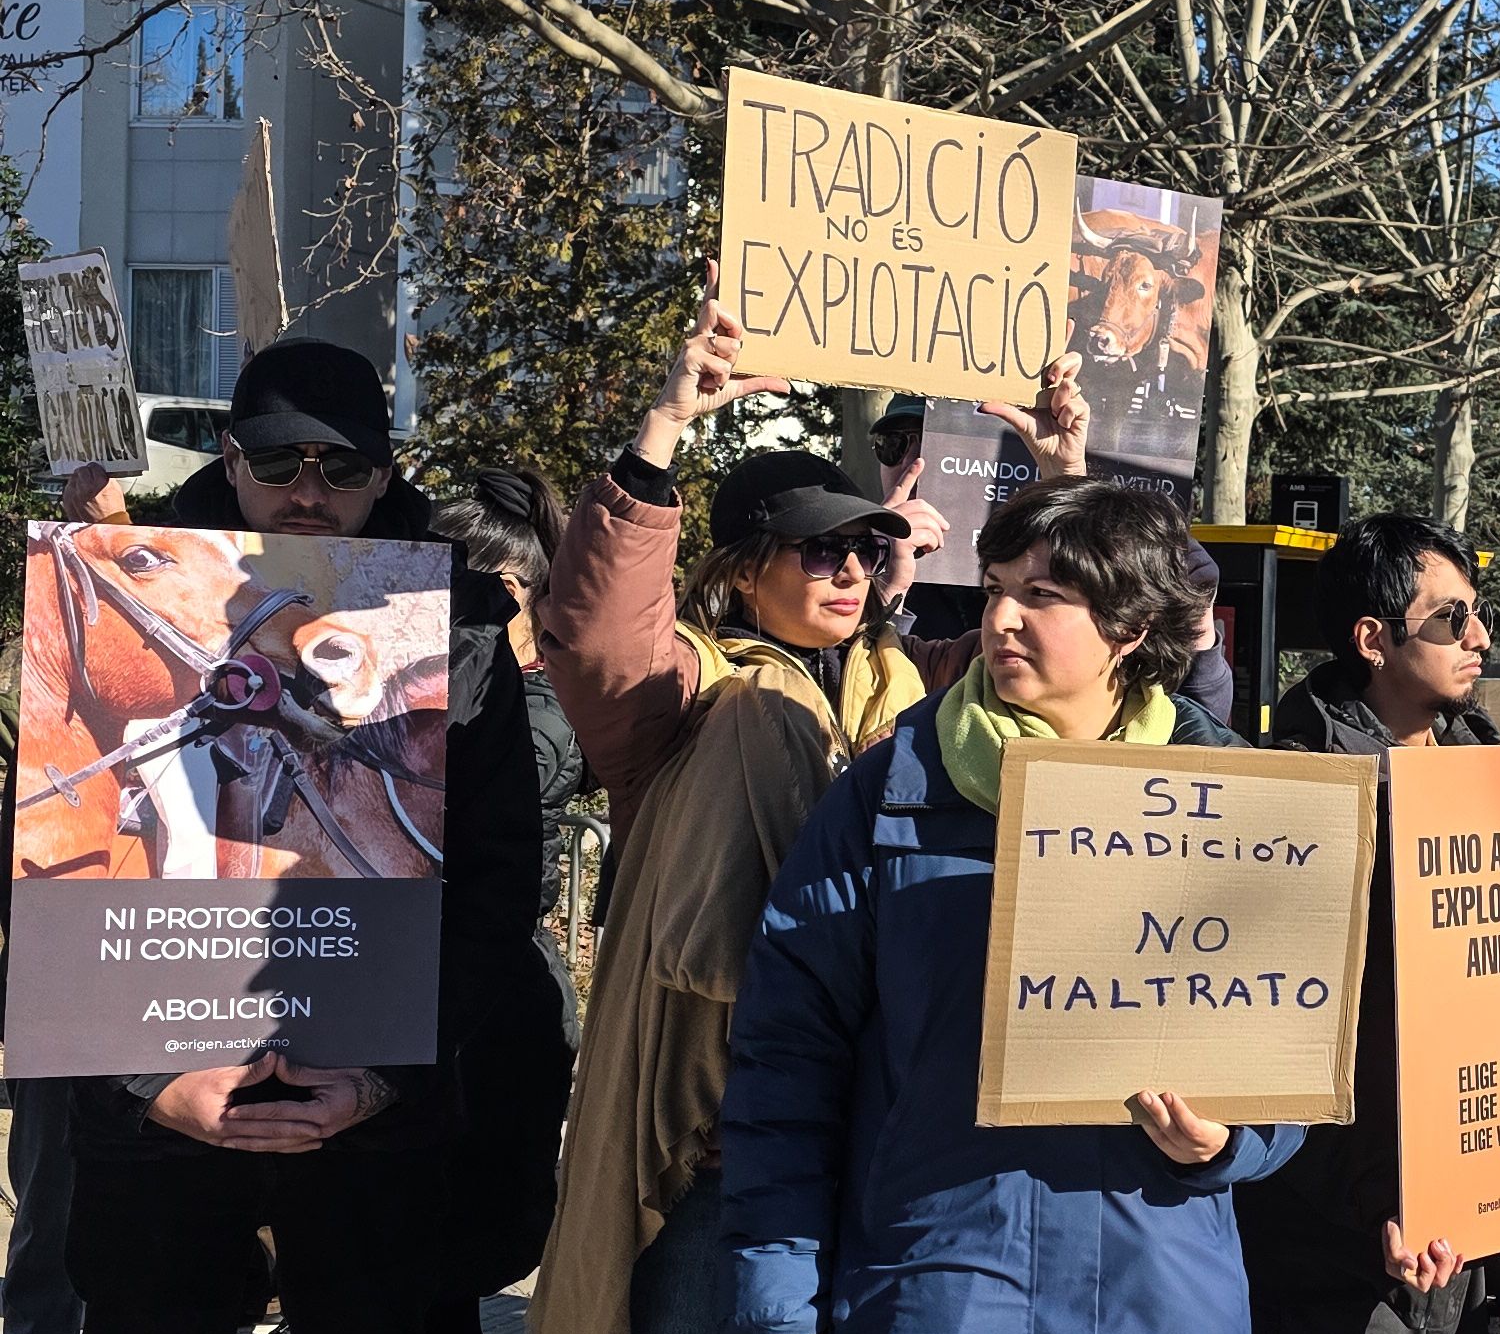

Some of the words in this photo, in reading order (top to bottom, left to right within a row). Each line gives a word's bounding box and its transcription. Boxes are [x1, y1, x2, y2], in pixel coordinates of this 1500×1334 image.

[827, 216, 868, 242] NO
[892, 221, 923, 252] ÉS
[741, 240, 1050, 379] EXPLOTACIÓ
[940, 456, 1030, 480] CUANDO
[983, 484, 1009, 503] SE
[1142, 777, 1223, 819] SI
[1418, 836, 1442, 878] DI
[1449, 833, 1482, 875] NO
[104, 907, 136, 930] NI
[146, 906, 358, 930] PROTOCOLOS,
[1135, 911, 1230, 955] NO
[100, 938, 131, 960] NI
[140, 936, 360, 960] CONDICIONES:
[142, 991, 311, 1021] ABOLICIÓN
[1018, 972, 1329, 1011] MALTRATO
[165, 1037, 290, 1053] @origen.activismo
[1458, 1061, 1497, 1094] ELIGE
[1459, 1092, 1497, 1125] ELIGE
[1460, 1126, 1493, 1155] ELIGE
